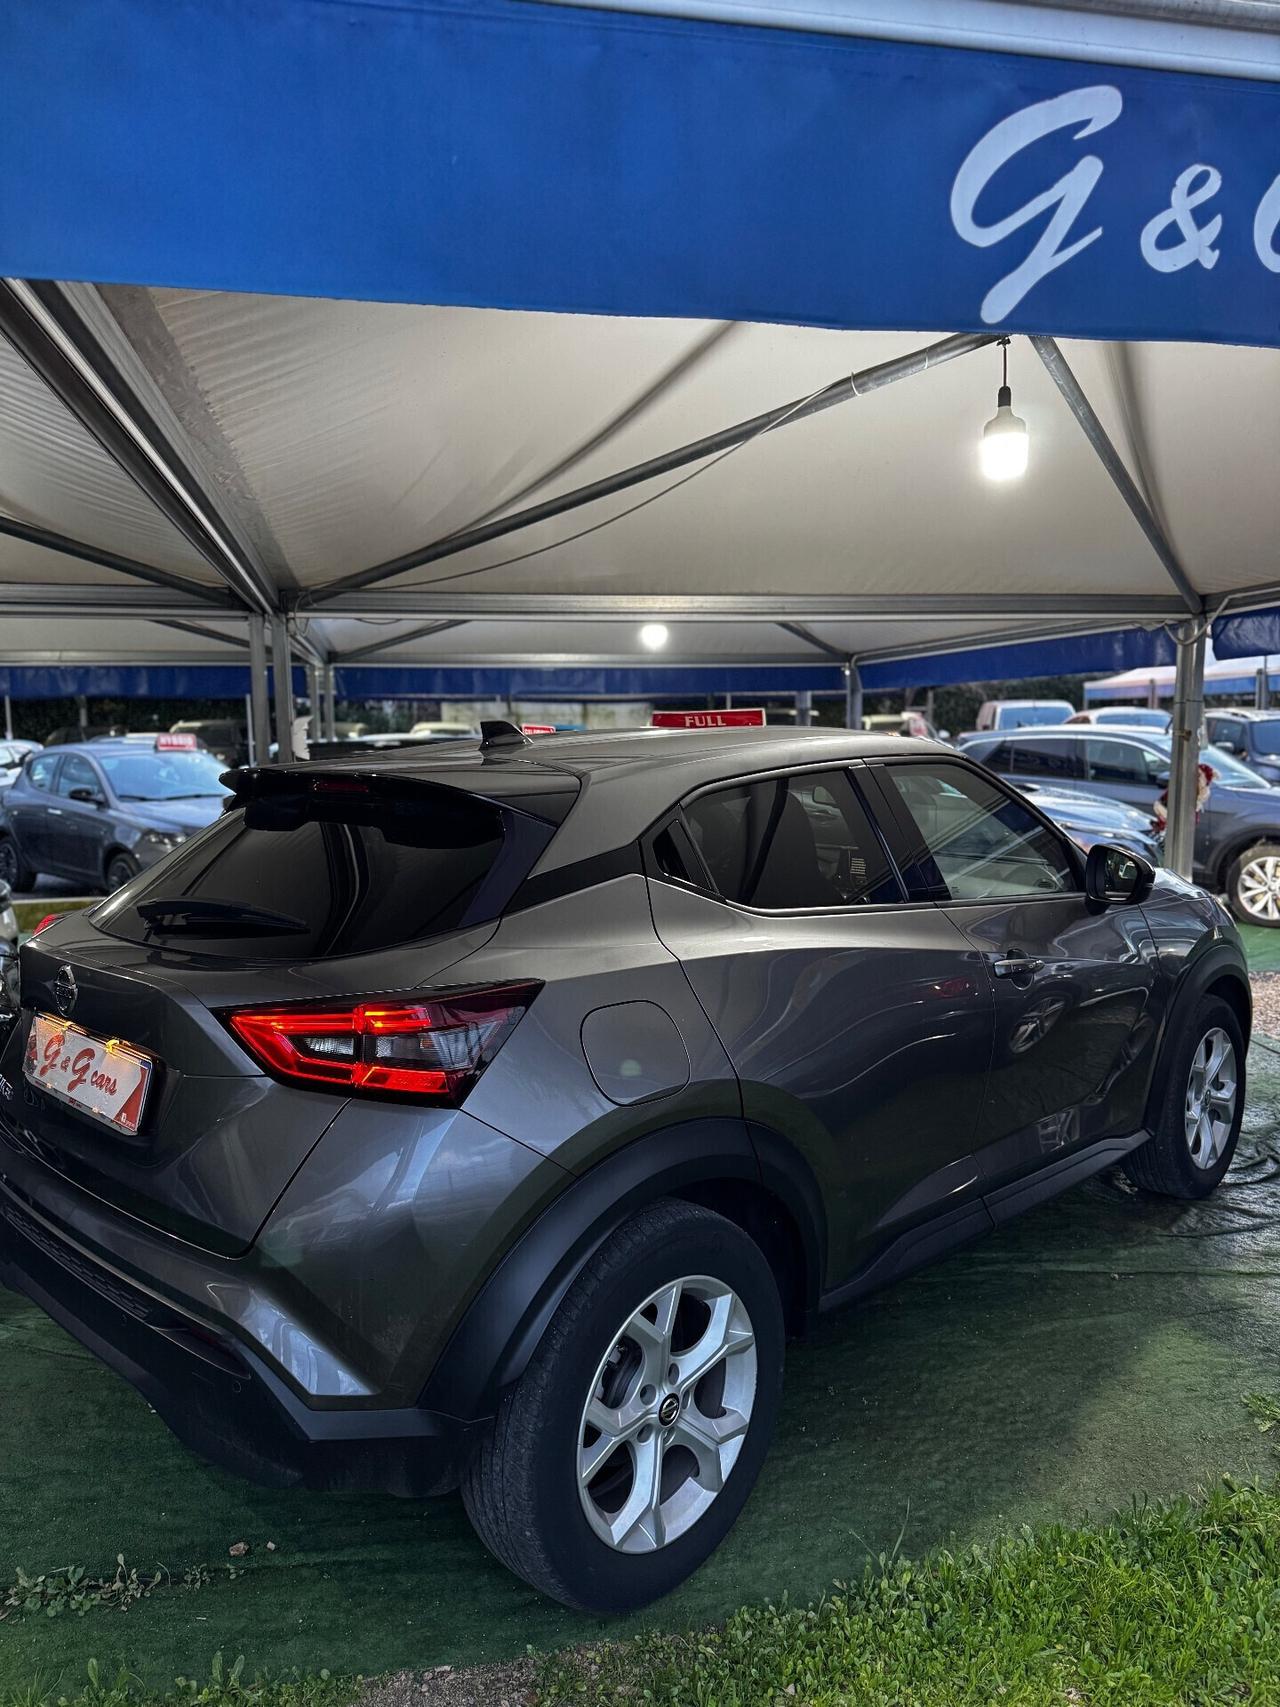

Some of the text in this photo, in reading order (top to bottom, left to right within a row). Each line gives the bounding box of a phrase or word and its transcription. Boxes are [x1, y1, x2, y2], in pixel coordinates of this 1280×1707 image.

[949, 84, 1124, 325] G
[1140, 163, 1223, 273] &
[684, 715, 727, 727] FULL
[40, 1033, 118, 1096] G & G cars
